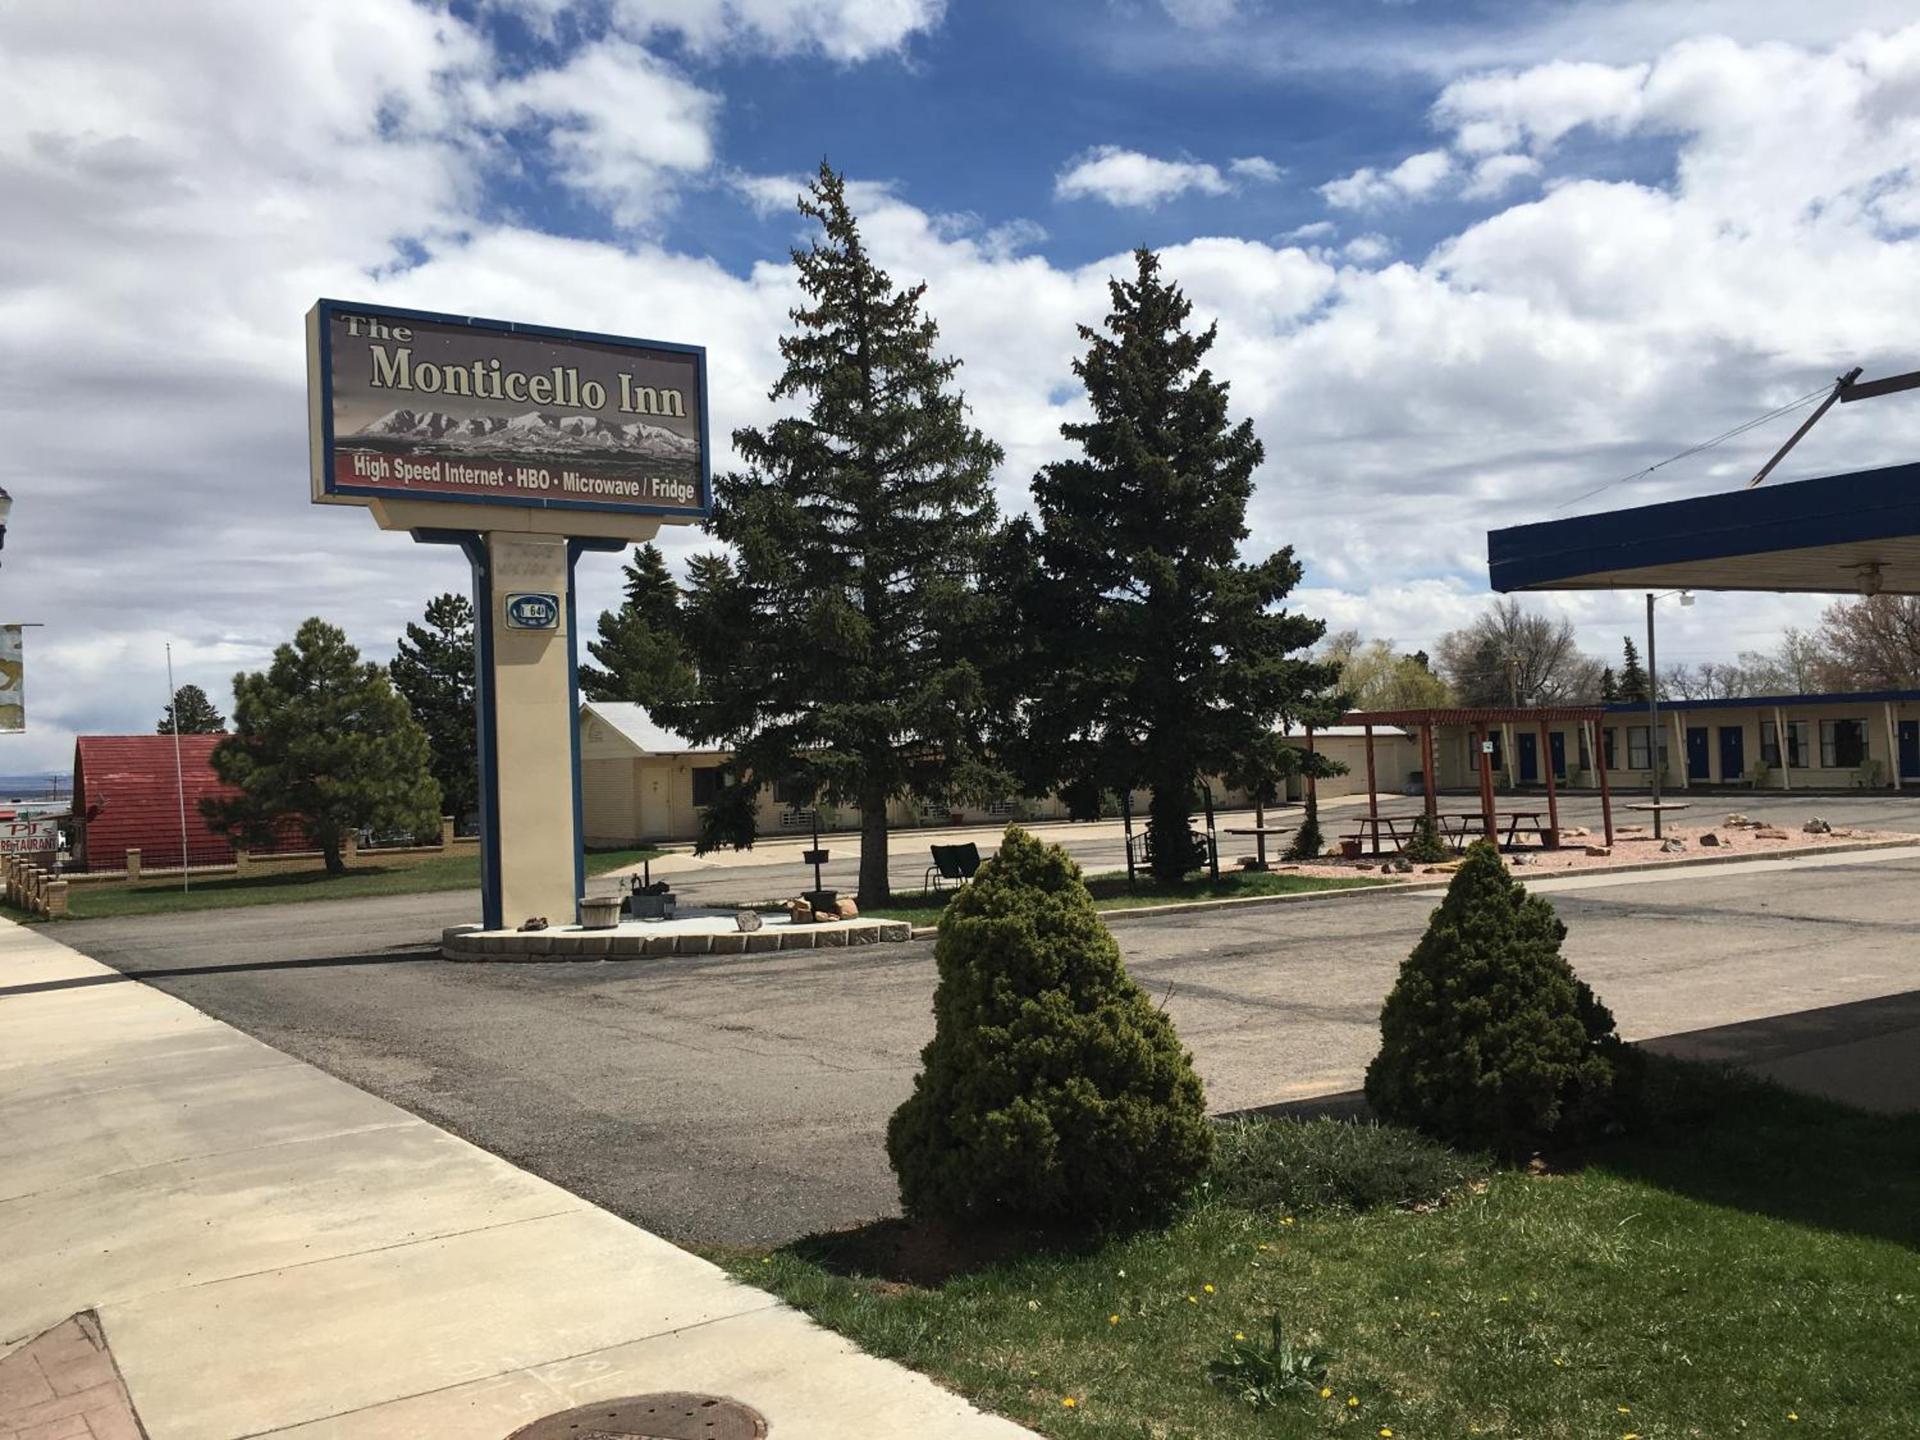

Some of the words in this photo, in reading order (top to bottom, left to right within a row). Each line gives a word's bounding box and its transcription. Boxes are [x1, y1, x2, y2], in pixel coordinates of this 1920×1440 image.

[340, 315, 413, 342] The
[369, 345, 606, 410] Monticello
[617, 373, 686, 417] Inn
[354, 455, 390, 481] High
[394, 458, 440, 484] Speed
[445, 461, 505, 487] Internet
[516, 467, 550, 490] HBO
[562, 471, 640, 496] Microwave
[652, 478, 696, 503] Fridge
[0, 838, 57, 853] RETAURANT
